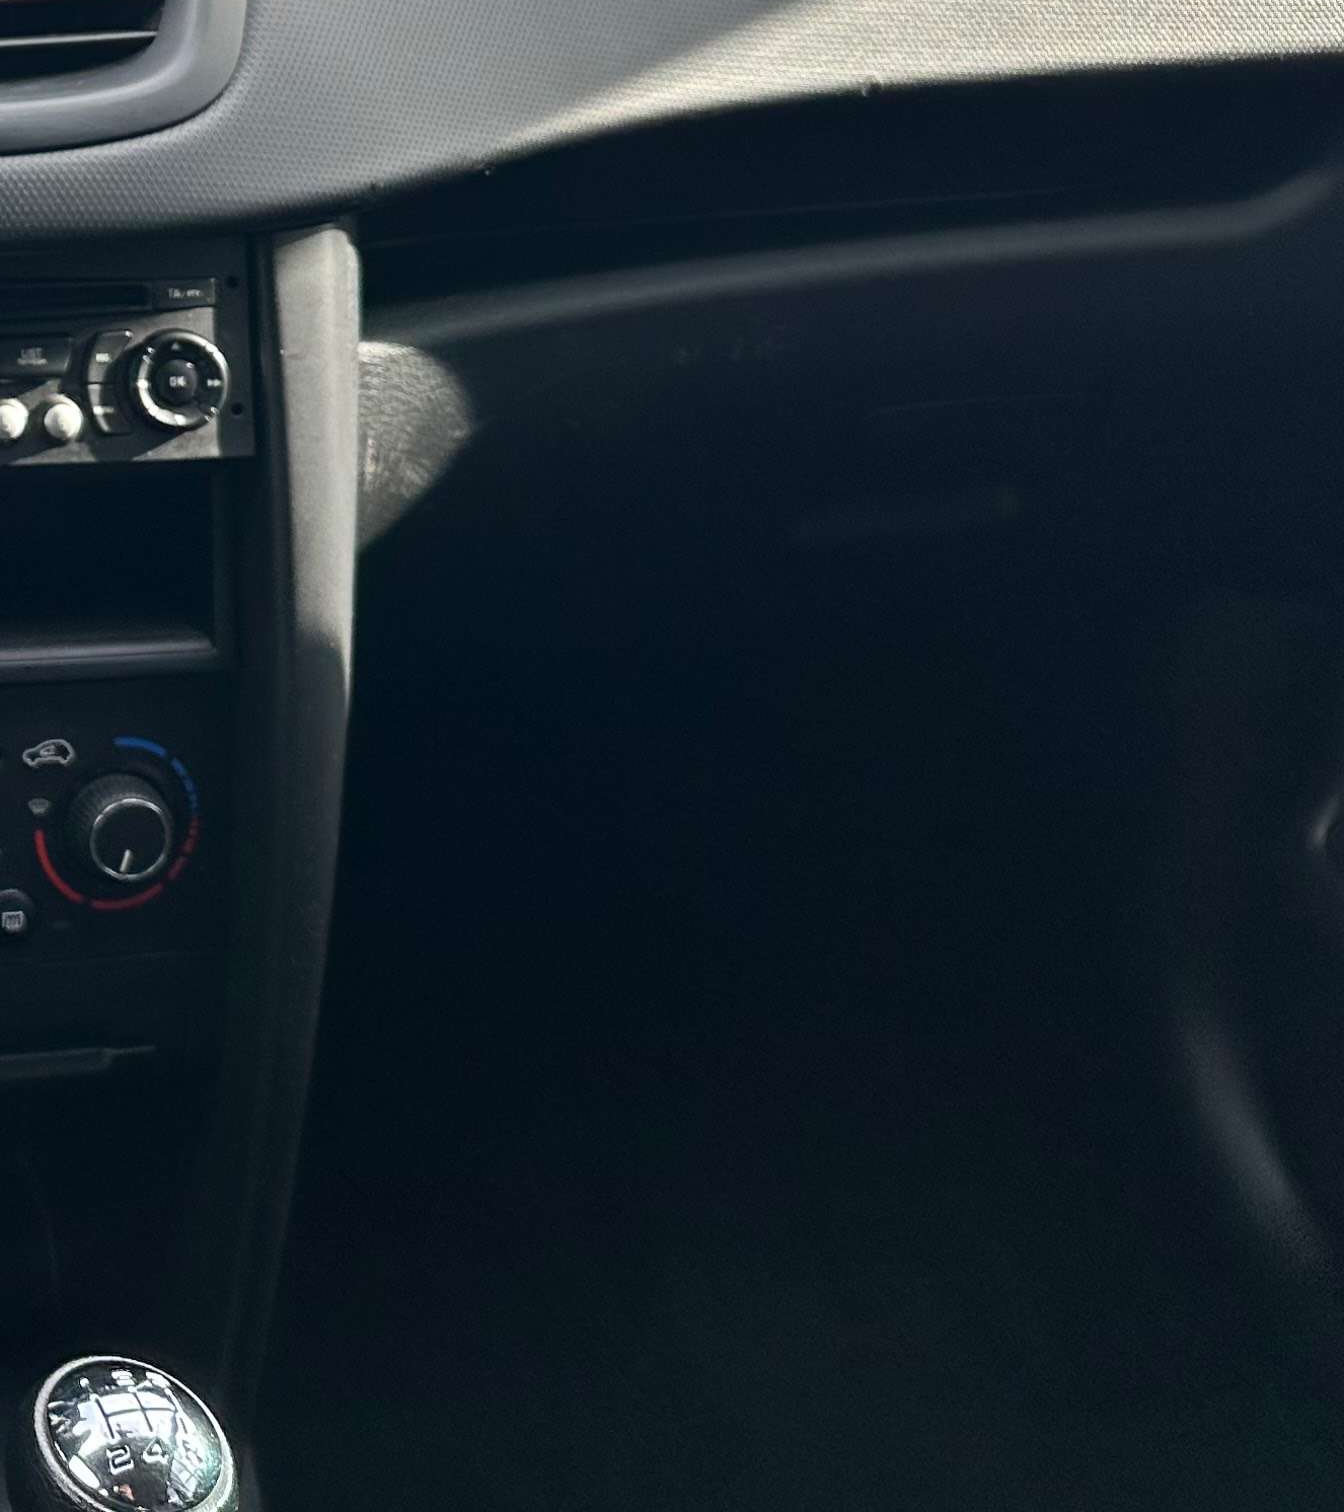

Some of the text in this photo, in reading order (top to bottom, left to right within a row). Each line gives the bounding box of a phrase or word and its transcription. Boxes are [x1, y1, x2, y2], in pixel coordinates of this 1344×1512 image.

[169, 375, 187, 388] OK
[107, 1444, 134, 1475] 2
[143, 1438, 170, 1463] 4
